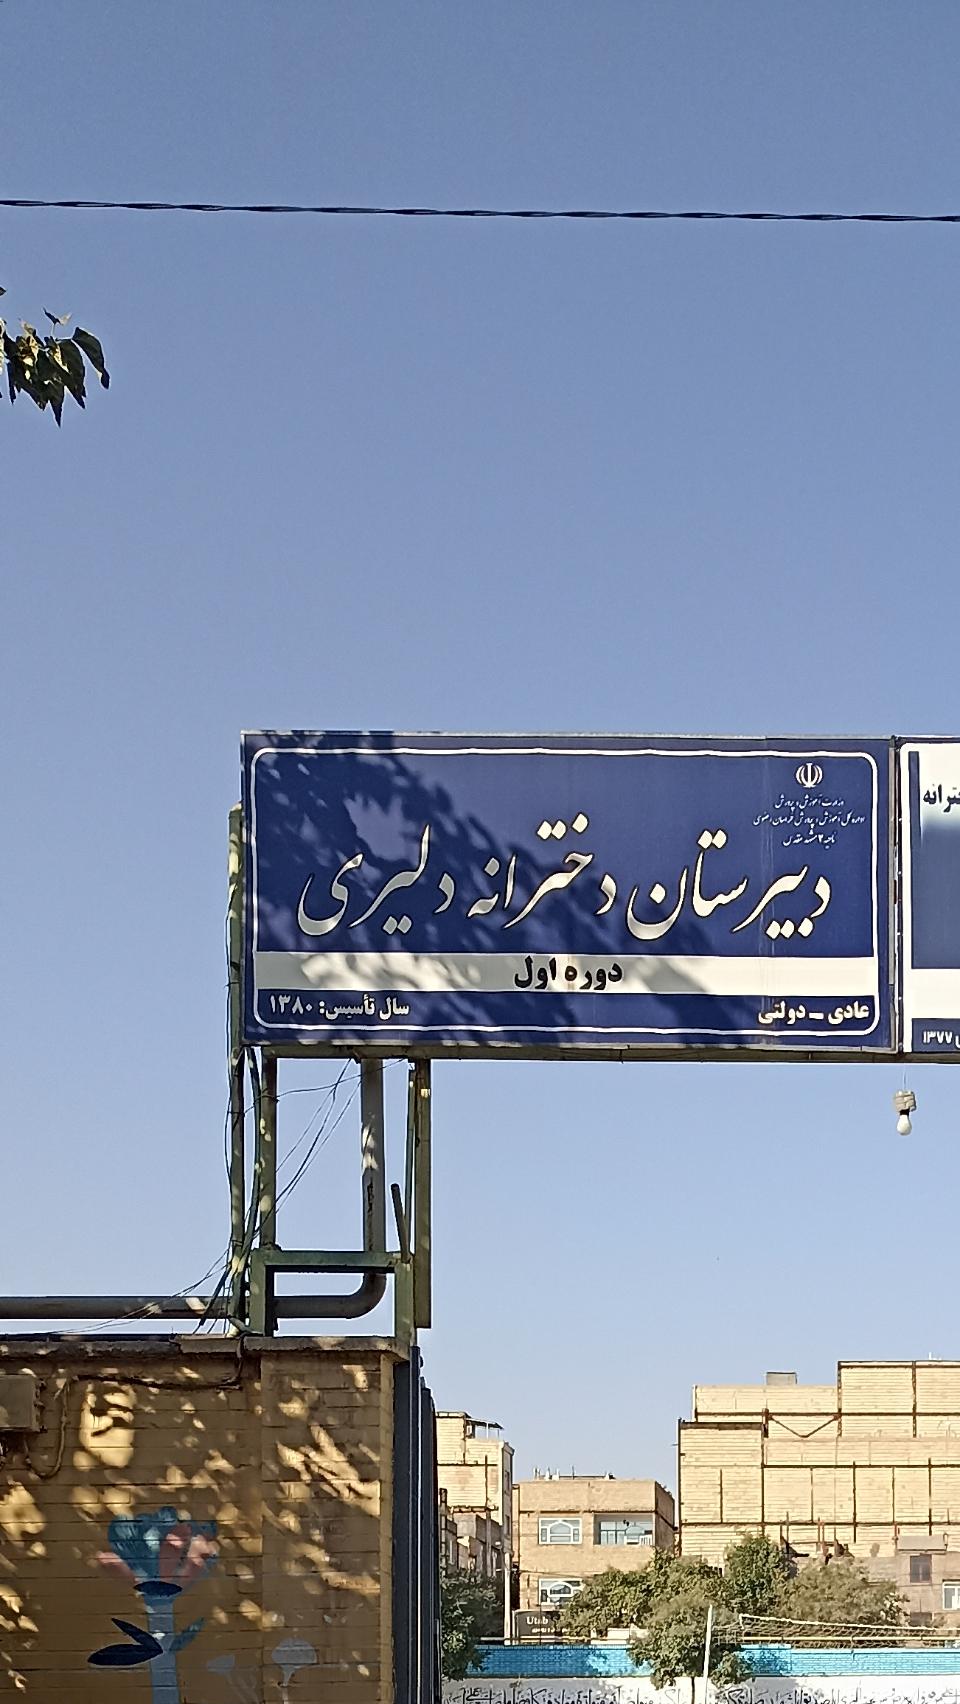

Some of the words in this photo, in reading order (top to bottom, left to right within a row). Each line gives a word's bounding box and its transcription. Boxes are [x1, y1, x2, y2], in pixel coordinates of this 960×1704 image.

[297, 823, 456, 937] دلیری
[467, 812, 617, 930] دخترانه
[626, 829, 832, 942] دبیرستان
[514, 955, 557, 989] اول
[565, 963, 623, 991] دوره
[270, 994, 313, 1014] ۱۳۸۰
[379, 996, 410, 1020] سال
[758, 1000, 806, 1025] دولتی
[827, 1000, 870, 1025] عادی
[923, 1030, 953, 1044] ۱۳۷۷
